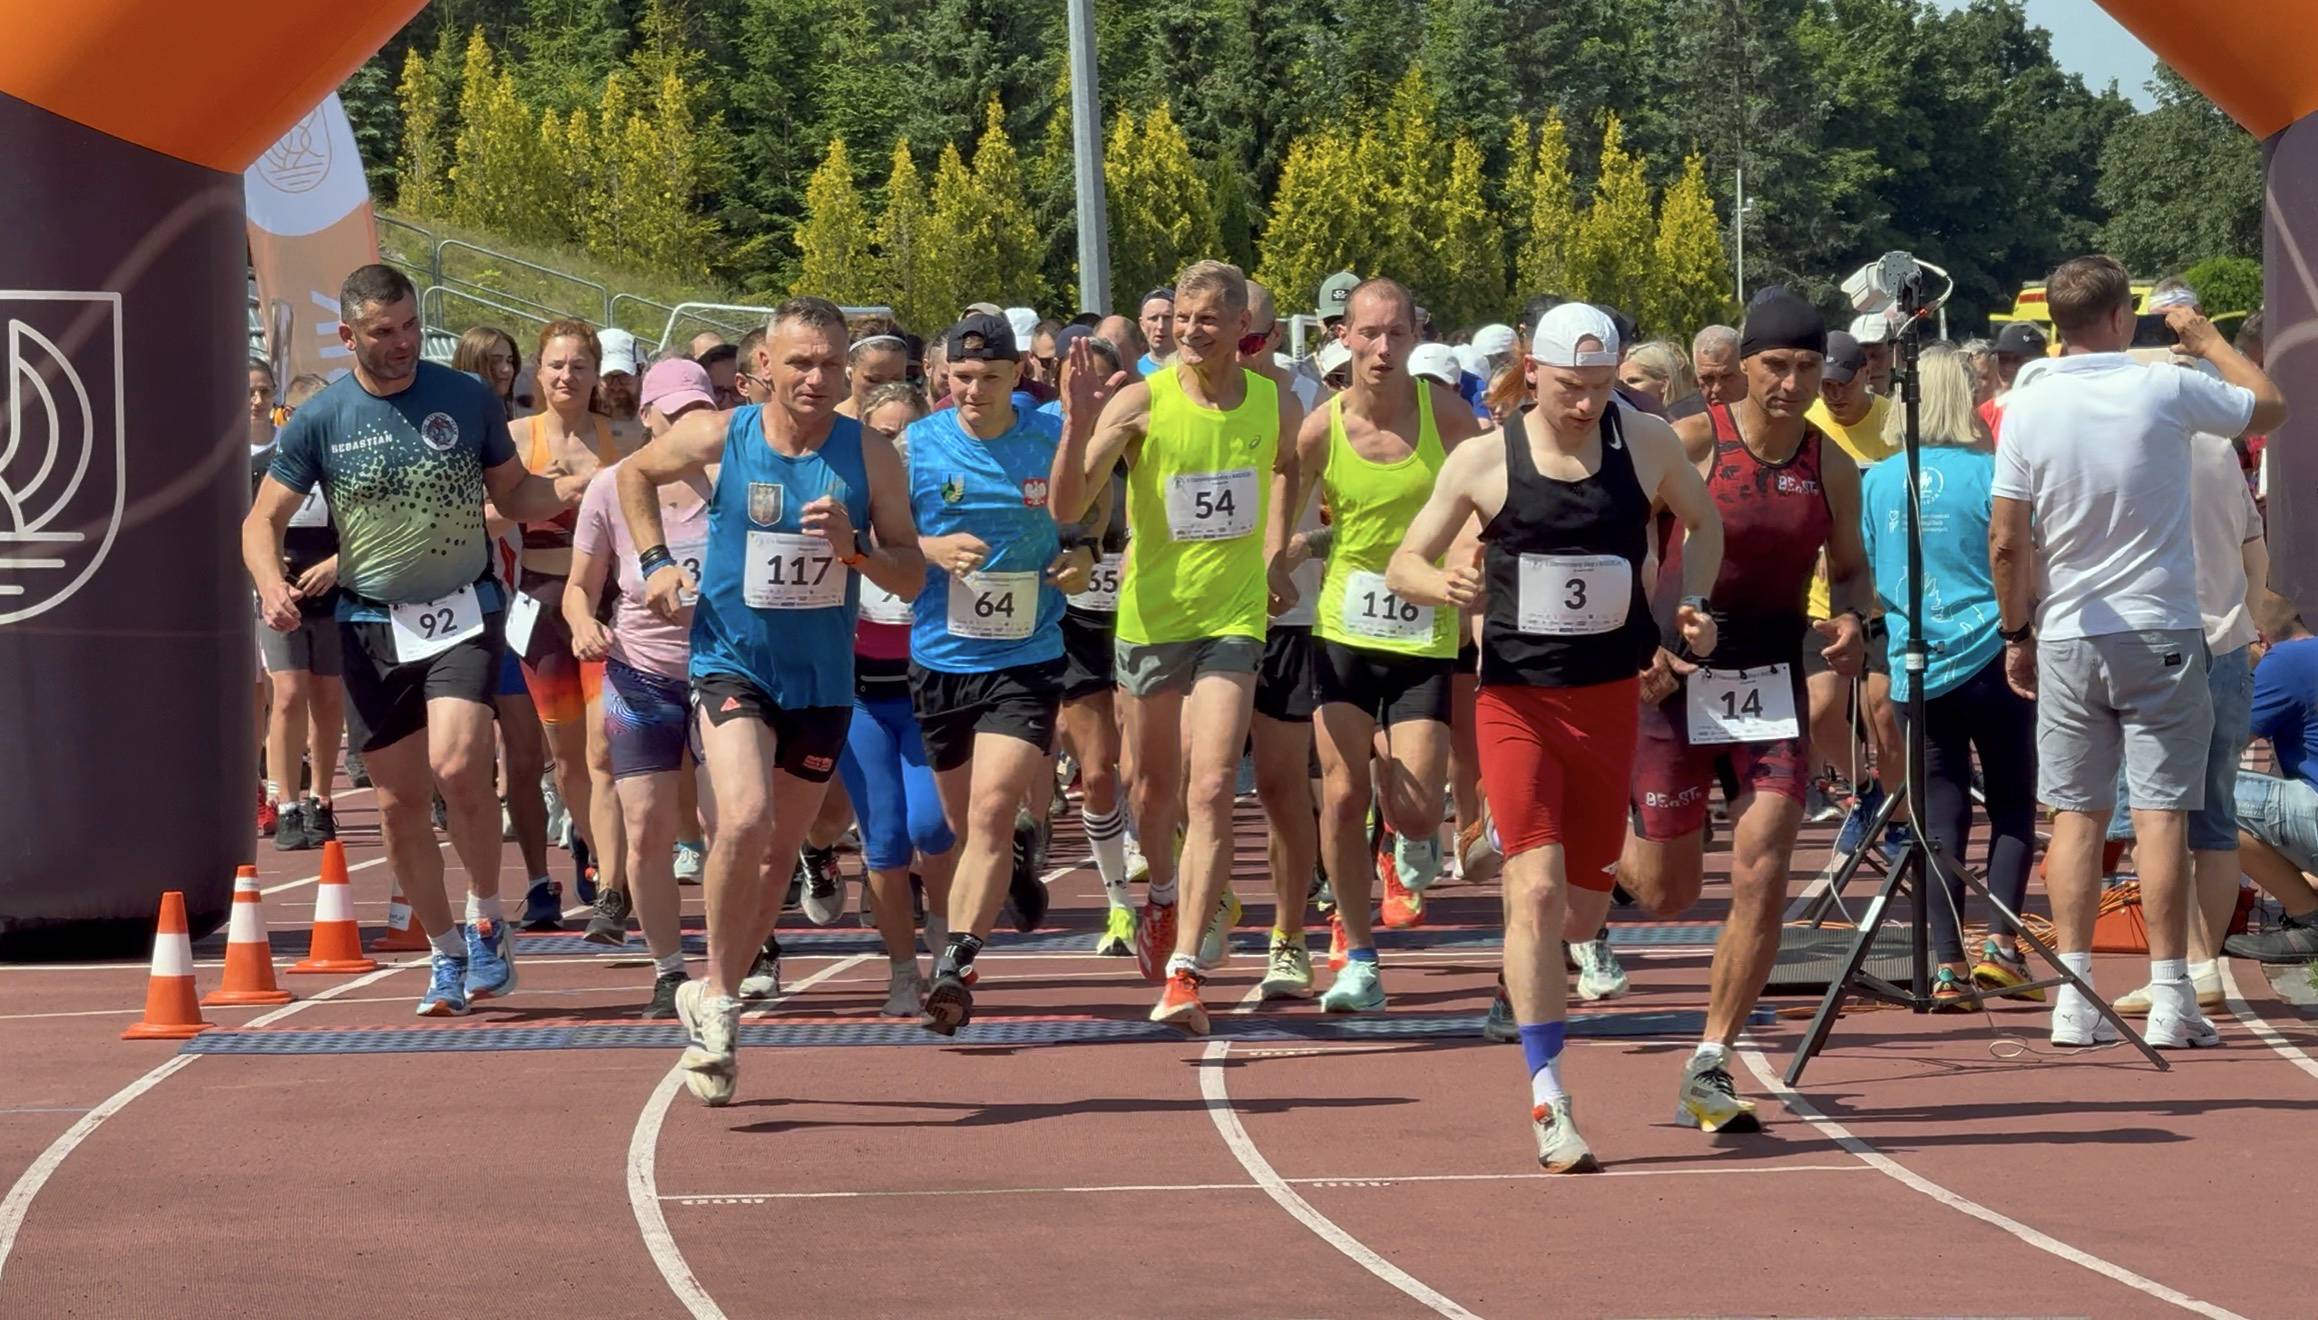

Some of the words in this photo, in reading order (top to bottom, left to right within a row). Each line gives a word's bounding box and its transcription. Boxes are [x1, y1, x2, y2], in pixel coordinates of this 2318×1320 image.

[331, 433, 393, 453] SEBASTIAN
[1195, 489, 1235, 519] 54
[767, 554, 833, 586] 117
[974, 591, 1015, 618] 64
[1362, 591, 1419, 622] 116
[1564, 578, 1587, 610] 3
[419, 607, 458, 639] 92
[1720, 688, 1763, 720] 14
